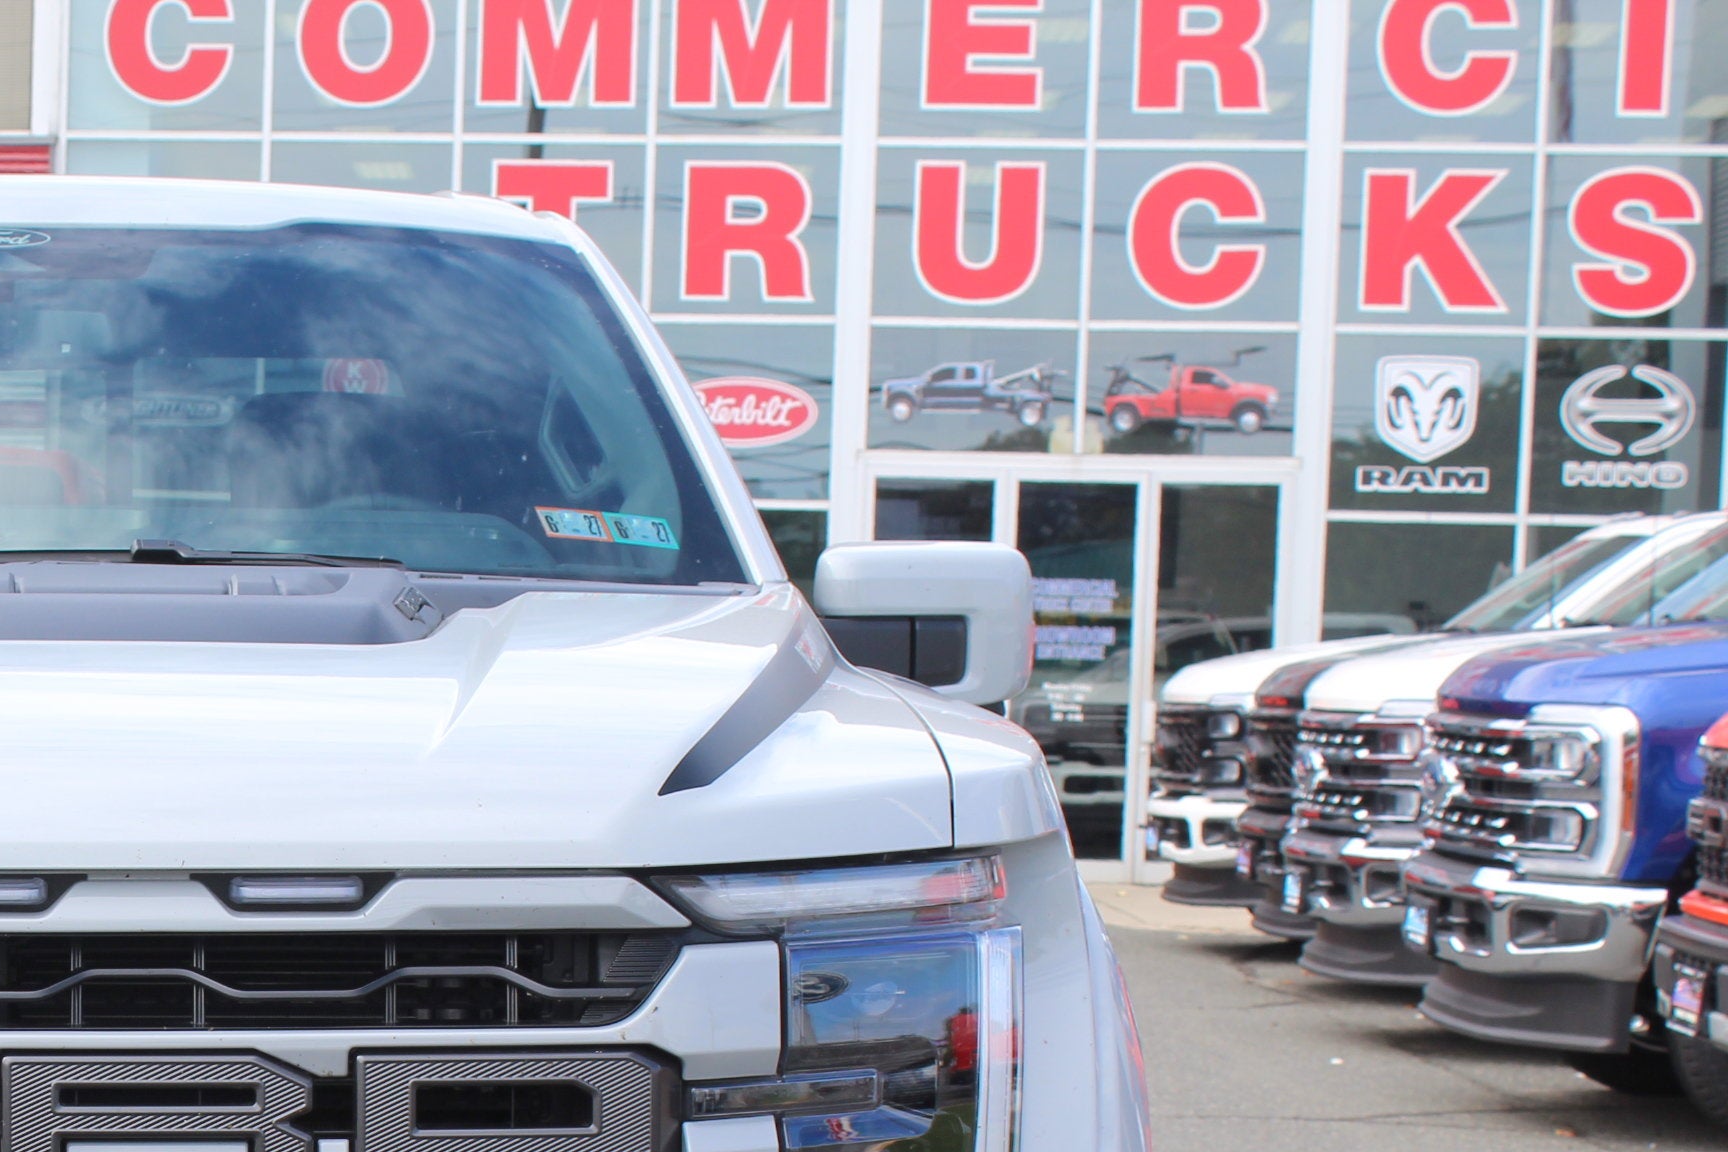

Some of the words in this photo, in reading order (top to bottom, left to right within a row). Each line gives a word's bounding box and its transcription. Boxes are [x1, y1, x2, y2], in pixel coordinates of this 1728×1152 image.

[104, 0, 1670, 117] COMMERCI
[491, 158, 1704, 318] TRUCKS
[696, 391, 803, 427] terbilt
[1355, 465, 1491, 493] RAM
[1562, 461, 1689, 488] HINO
[583, 513, 603, 537] 27
[651, 521, 671, 544] 27
